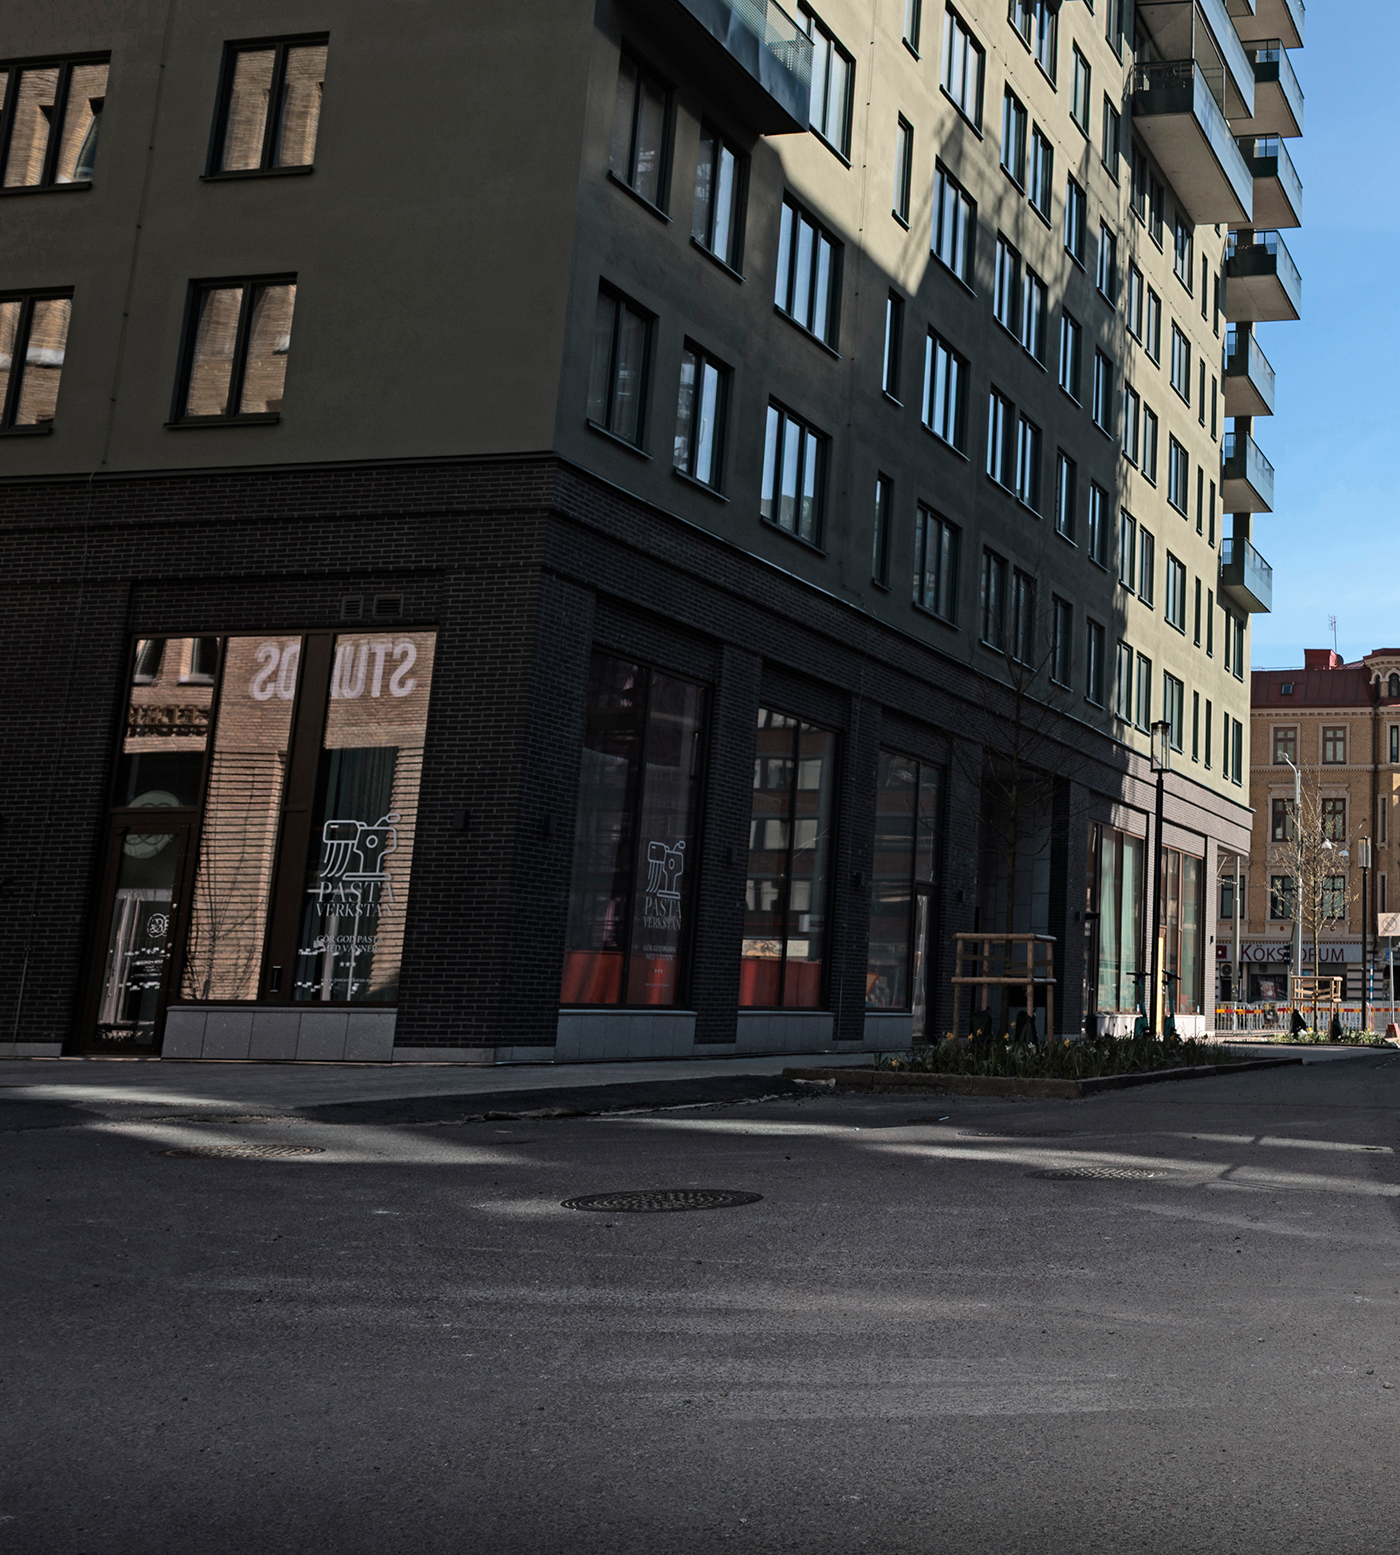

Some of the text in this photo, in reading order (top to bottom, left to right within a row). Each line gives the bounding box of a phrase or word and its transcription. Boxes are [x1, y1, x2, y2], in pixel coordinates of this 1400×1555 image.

[316, 880, 394, 903] PASTA
[315, 902, 394, 918] VERKSTAN
[644, 896, 682, 919] PASTA
[643, 914, 681, 931] VERKSTAN
[336, 934, 356, 943] GOD
[357, 934, 384, 944] PASTA
